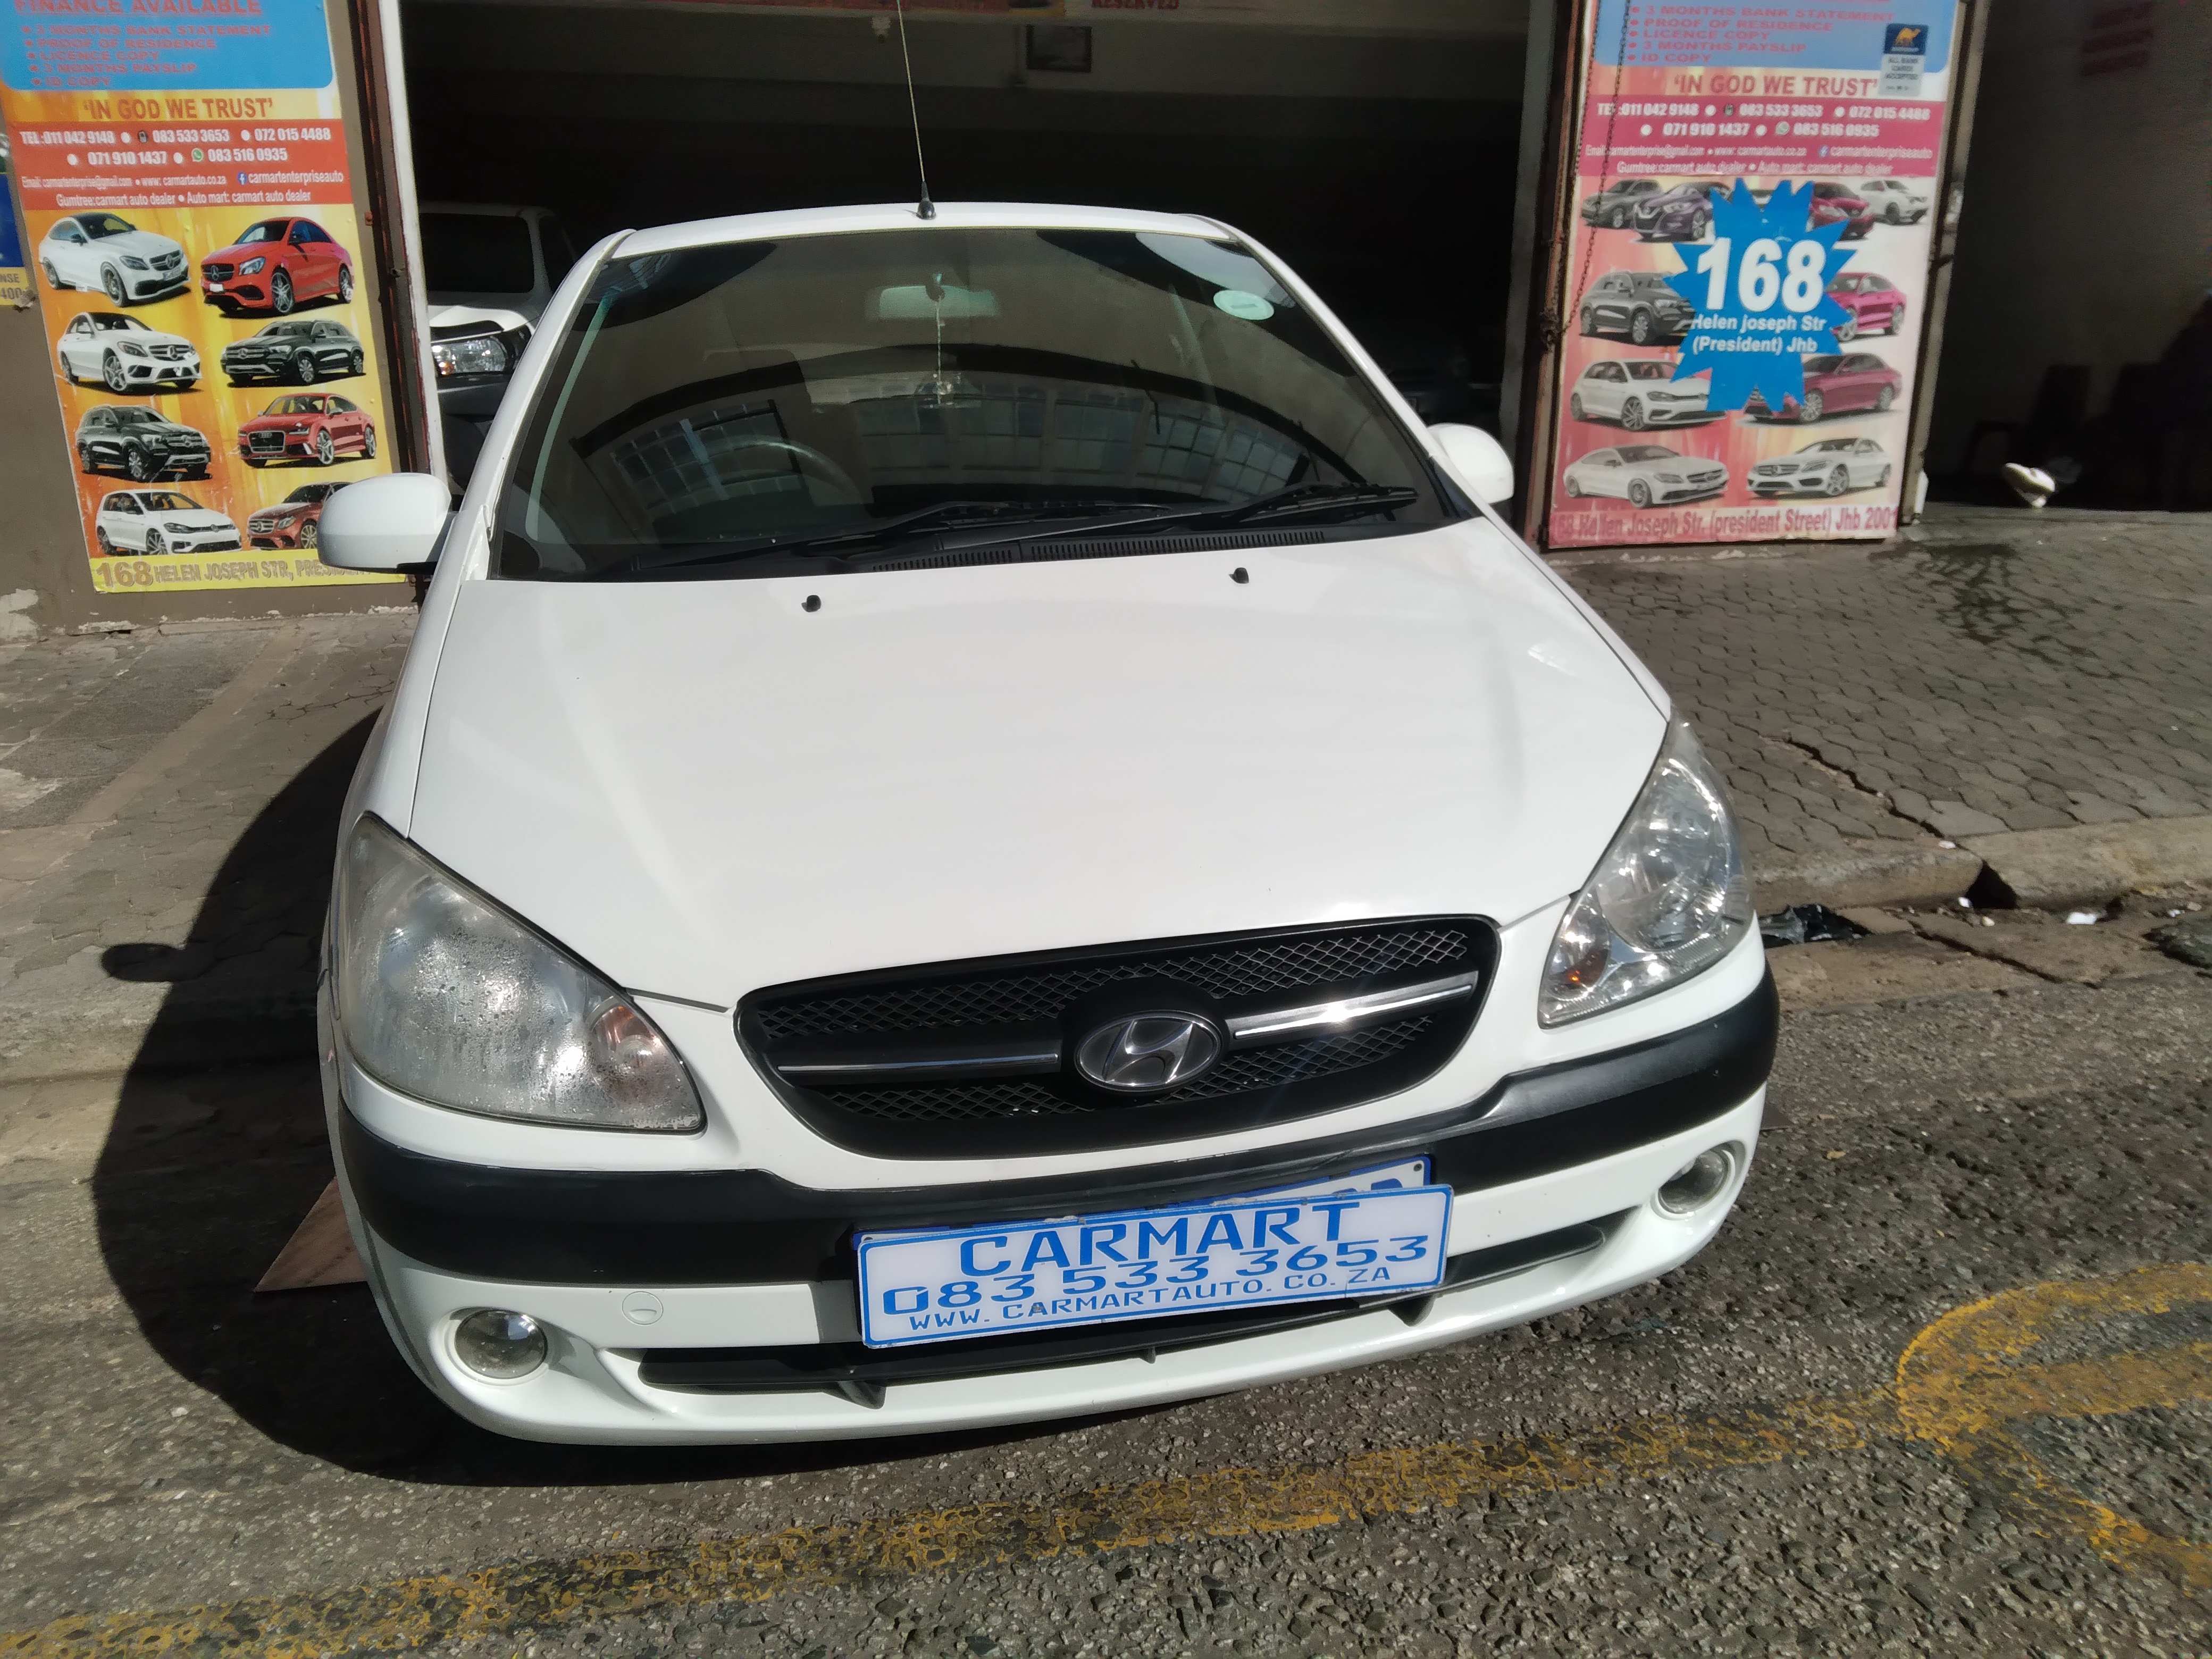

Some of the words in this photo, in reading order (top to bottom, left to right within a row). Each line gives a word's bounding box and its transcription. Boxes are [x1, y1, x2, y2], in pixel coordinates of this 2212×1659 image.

[1660, 6, 1735, 15] MONTHS
[1741, 7, 1789, 17] BANK
[1796, 10, 1895, 21] STATEMENT
[49, 24, 121, 35] MONTHS
[125, 25, 171, 35] BANK
[177, 25, 271, 36] STATEMENT
[1644, 18, 1701, 28] PROOF
[1708, 19, 1729, 28] OF
[1736, 20, 1833, 31] RESIDENCE
[1643, 29, 1717, 39] LICENCE
[1724, 30, 1771, 40] COPY
[37, 38, 91, 48] PROOF
[98, 38, 118, 48] OF
[125, 38, 216, 49] RESIDENCE
[1658, 41, 1732, 51] MONTHS
[1737, 43, 1806, 52] PAYSLIP
[40, 51, 110, 61] LICENCE
[115, 51, 161, 61] COPY
[1641, 53, 1659, 62] ID
[1664, 54, 1712, 63] COPY
[57, 63, 127, 73] MONTHS
[132, 63, 197, 73] PAYSLIP
[67, 76, 111, 86] COPY
[1710, 75, 1756, 94] GOD
[1764, 75, 1796, 95] WE
[118, 98, 161, 119] GOD
[165, 98, 196, 119] WE
[1644, 103, 1668, 116] 042
[153, 130, 175, 143] 083
[177, 129, 198, 142] 533
[200, 129, 230, 142] 3653
[255, 129, 275, 141] 072
[277, 128, 298, 141] 015
[301, 128, 331, 140] 4488
[1663, 122, 1687, 136] 071
[1689, 123, 1716, 136] 910
[1718, 123, 1751, 136] 1437
[1821, 123, 1844, 136] 516
[64, 131, 86, 144] 042
[87, 130, 116, 144] 9148
[88, 152, 111, 165] 071
[112, 152, 137, 165] 910
[138, 151, 167, 164] 1437
[207, 149, 231, 162] 083
[233, 148, 255, 162] 516
[256, 148, 288, 161] 0935
[248, 170, 344, 186] carmartenterpriseauto
[129, 194, 148, 206] auto
[149, 192, 175, 205] dealer
[187, 191, 206, 204] Auto
[232, 190, 264, 203] carmart
[265, 190, 283, 202] auto
[286, 189, 311, 202] dealer
[1696, 237, 1826, 313] 168
[1691, 313, 1738, 330] Helen
[1801, 315, 1828, 331] Str
[1692, 336, 1783, 356] (President)
[1787, 336, 1818, 353] Jhb
[1627, 511, 1679, 540] Joseph
[1836, 507, 1861, 531] Jhb
[96, 561, 154, 589] 168
[154, 563, 202, 583] HELEN
[204, 561, 257, 581] JOSEPH
[262, 560, 294, 582] STR,
[960, 1202, 1359, 1277] CARMART
[883, 1274, 1035, 1314] 083
[1062, 1255, 1209, 1294] 533
[1236, 1235, 1428, 1276] 3653
